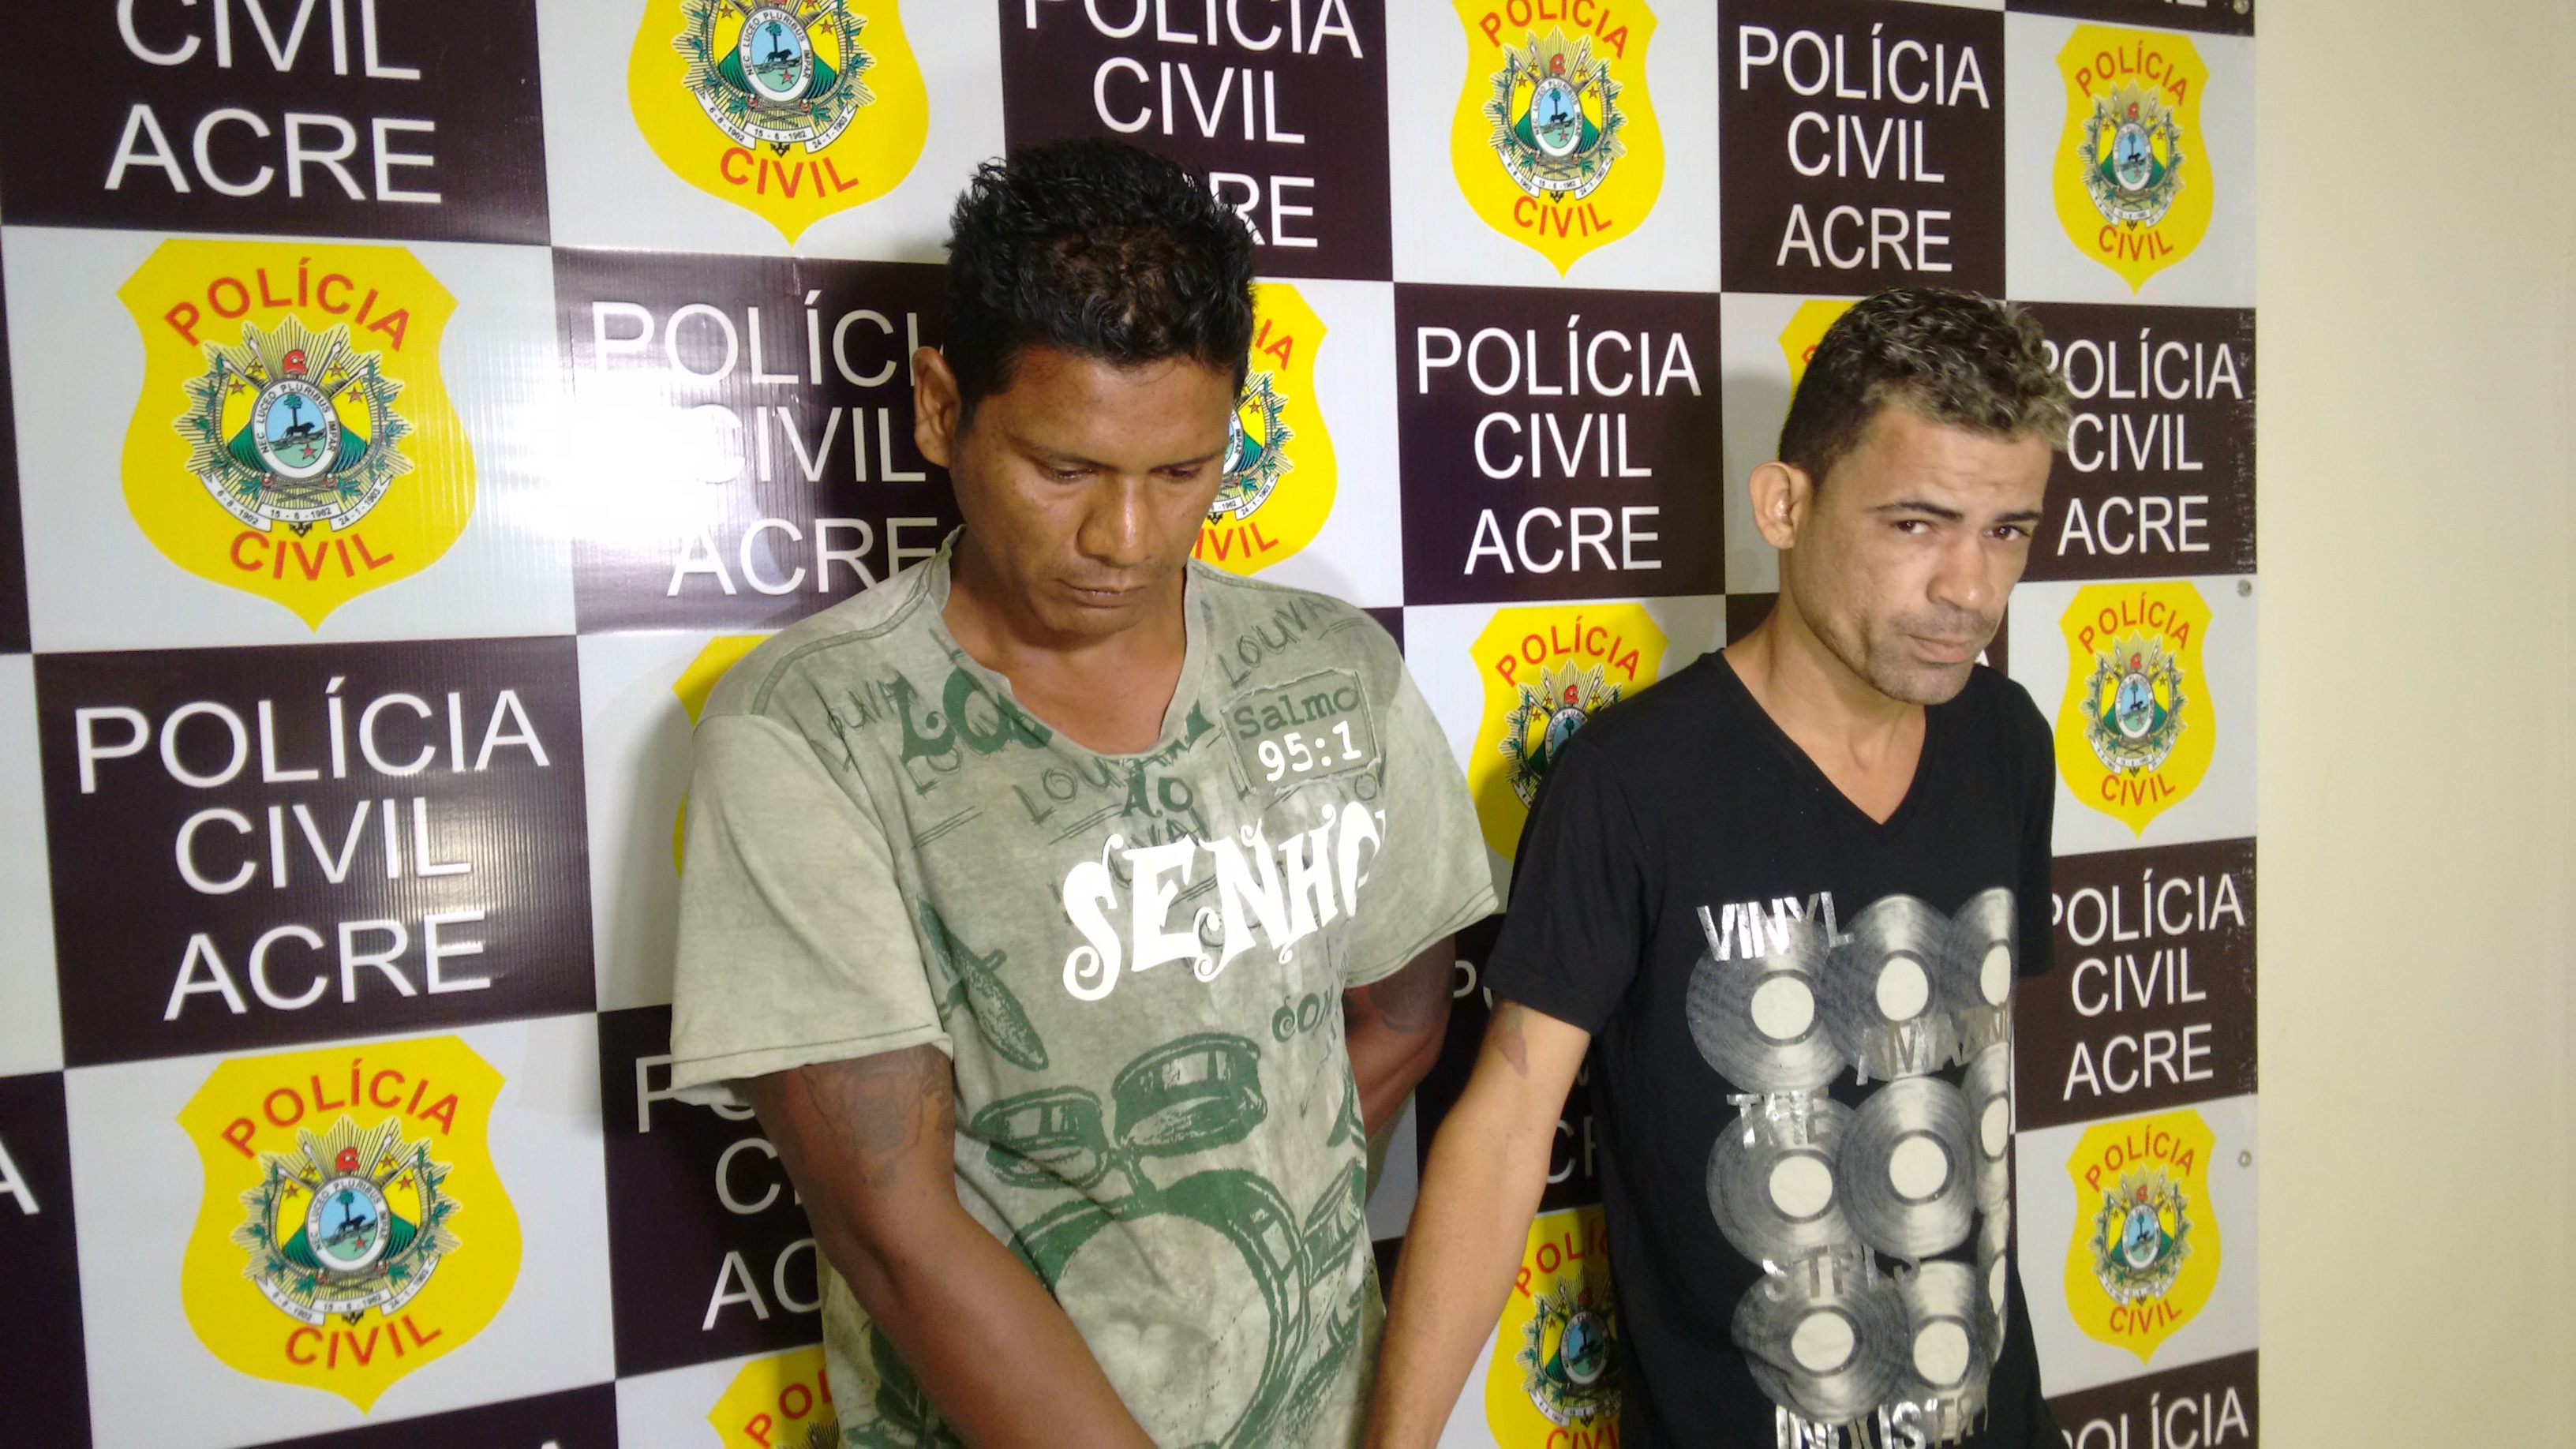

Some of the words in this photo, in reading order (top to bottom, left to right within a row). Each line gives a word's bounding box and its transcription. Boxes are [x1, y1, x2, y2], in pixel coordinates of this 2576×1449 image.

[118, 0, 421, 80] CIVIL
[743, 18, 759, 47] LUCEO
[763, 12, 805, 42] PLURIBUS
[743, 55, 754, 76] NEC
[1739, 23, 1990, 109] POLÍCIA
[2075, 39, 2188, 107] POLÍCIA
[1094, 57, 1305, 144] CIVIL
[104, 103, 442, 204] ACRE
[721, 148, 859, 199] CIVIL
[1787, 111, 1945, 183] CIVIL
[1208, 171, 1318, 247] RE
[1514, 195, 1612, 238] CIVIL
[1777, 204, 1953, 272] ACRE
[2098, 224, 2174, 262] CIVIL
[163, 257, 410, 352] POLÍCIA
[592, 290, 944, 388] POLÍCI
[1417, 314, 1702, 397] POLÍCIA
[256, 392, 276, 423] LUCEO
[281, 383, 331, 414] PLURIBUS
[256, 432, 269, 454] NEC
[1474, 412, 1652, 480] CIVIL
[2067, 413, 2203, 473] CIVIL
[230, 530, 395, 581] CIVIL
[1194, 521, 1279, 562] IVIL
[1464, 505, 1662, 575] ACRE
[2057, 495, 2210, 556] ACRE
[1496, 616, 1641, 687] POLÍCIA
[2078, 592, 2190, 654] POLÍCIA
[75, 676, 550, 794] POLÍCIA
[1233, 687, 1361, 740] Salmo
[1258, 720, 1362, 782] 95:1
[1120, 768, 1194, 818] AO
[2101, 773, 2176, 807] CIVIL
[175, 796, 472, 895] CIVIL
[1062, 801, 1386, 1002] SENHO
[1696, 890, 1855, 962] VINYL
[163, 909, 492, 1021] ACRE
[2072, 948, 2207, 1017] CIVIL
[2063, 1024, 2215, 1102] ACRE
[221, 1058, 460, 1159] POLÍCIA
[2085, 1125, 2196, 1193] POLÍCIA
[702, 1239, 822, 1331] AC
[1515, 1218, 1608, 1298] POLÍ
[286, 1315, 442, 1369] CIVIL
[2110, 1298, 2182, 1335] CIVIL
